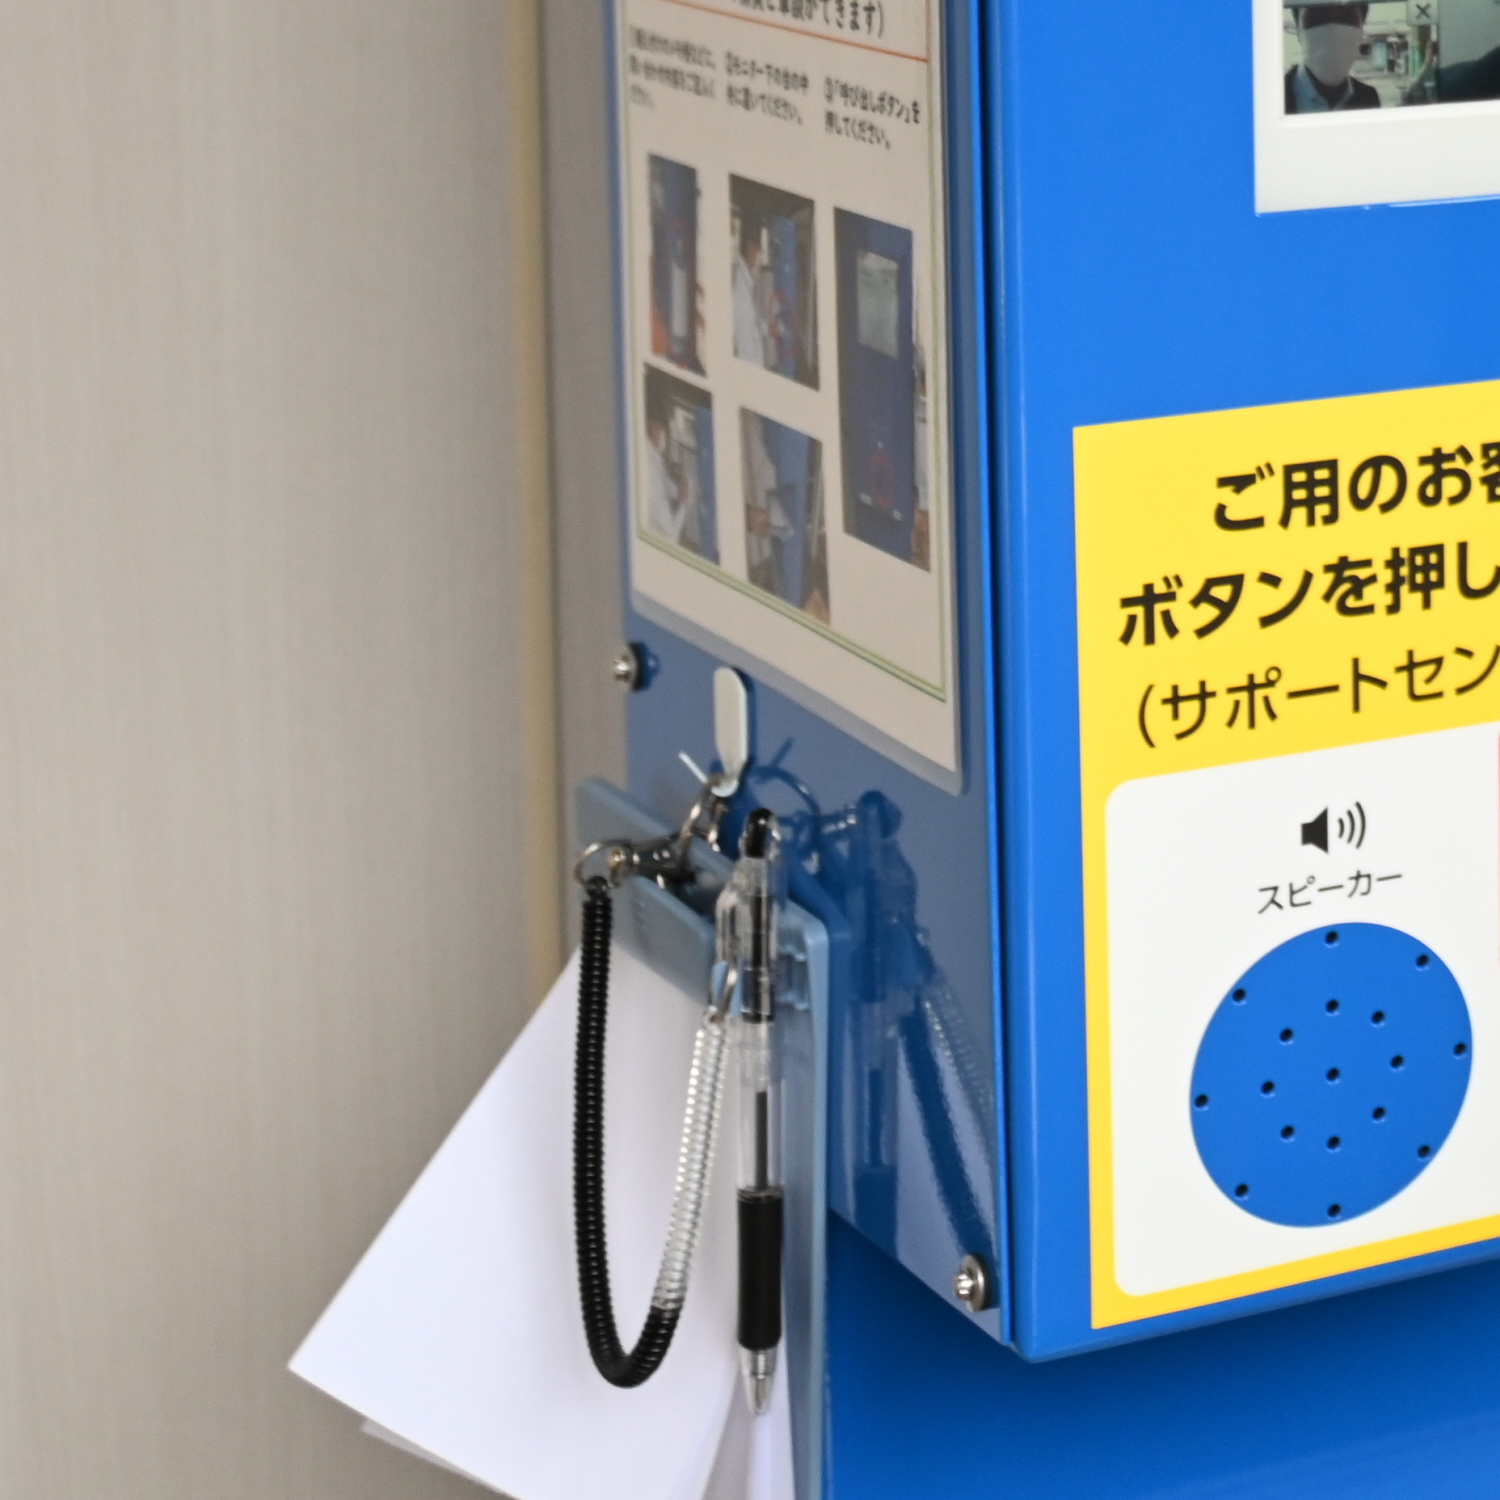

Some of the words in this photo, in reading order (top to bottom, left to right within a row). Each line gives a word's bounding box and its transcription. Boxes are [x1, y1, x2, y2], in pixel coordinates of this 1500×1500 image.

[1256, 870, 1403, 915] スピーカー
